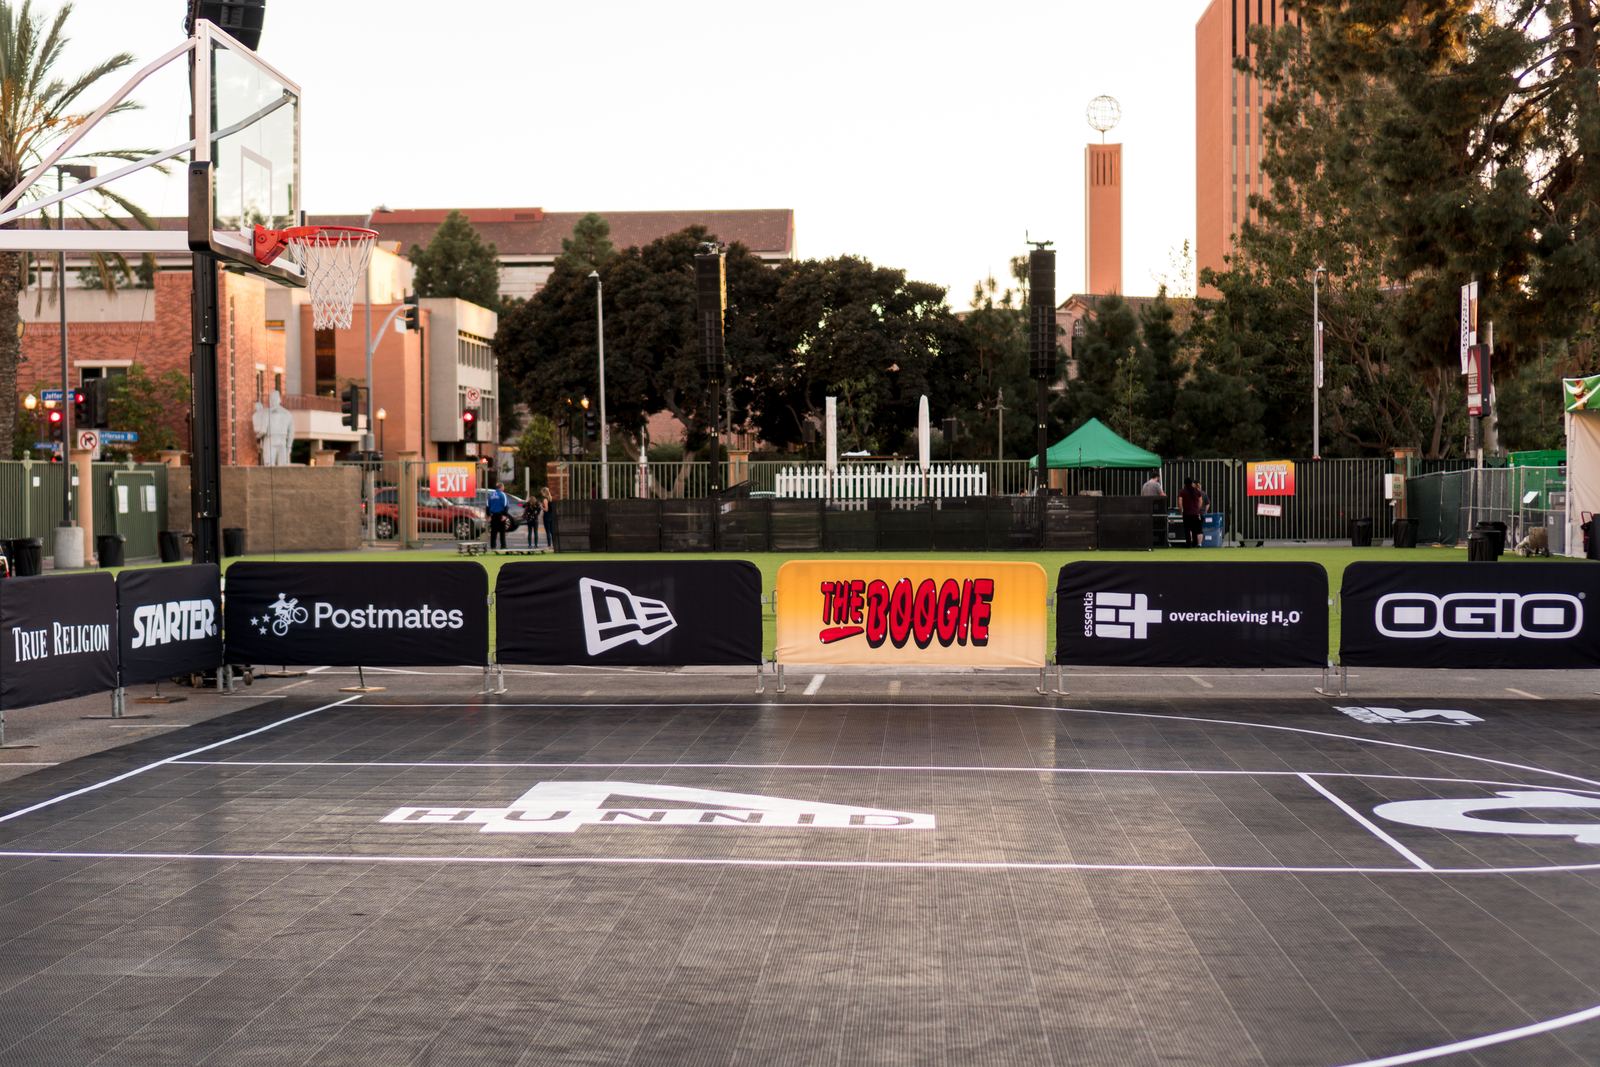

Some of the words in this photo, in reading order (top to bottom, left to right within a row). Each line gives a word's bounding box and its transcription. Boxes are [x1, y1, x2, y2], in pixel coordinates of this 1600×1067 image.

[45, 392, 74, 401] Jefferon
[437, 473, 469, 492] EXIT
[1254, 472, 1288, 490] EXIT
[131, 599, 216, 649] STARTER
[314, 602, 464, 629] Postmates
[820, 579, 866, 626] THE
[865, 578, 995, 650] BOOGIE
[1084, 591, 1094, 638] essentia
[1168, 610, 1268, 625] overachieving
[1375, 592, 1584, 639] OGIO
[12, 626, 48, 663] TRUE
[52, 621, 110, 656] RELIGION
[400, 808, 916, 827] HUNNID
